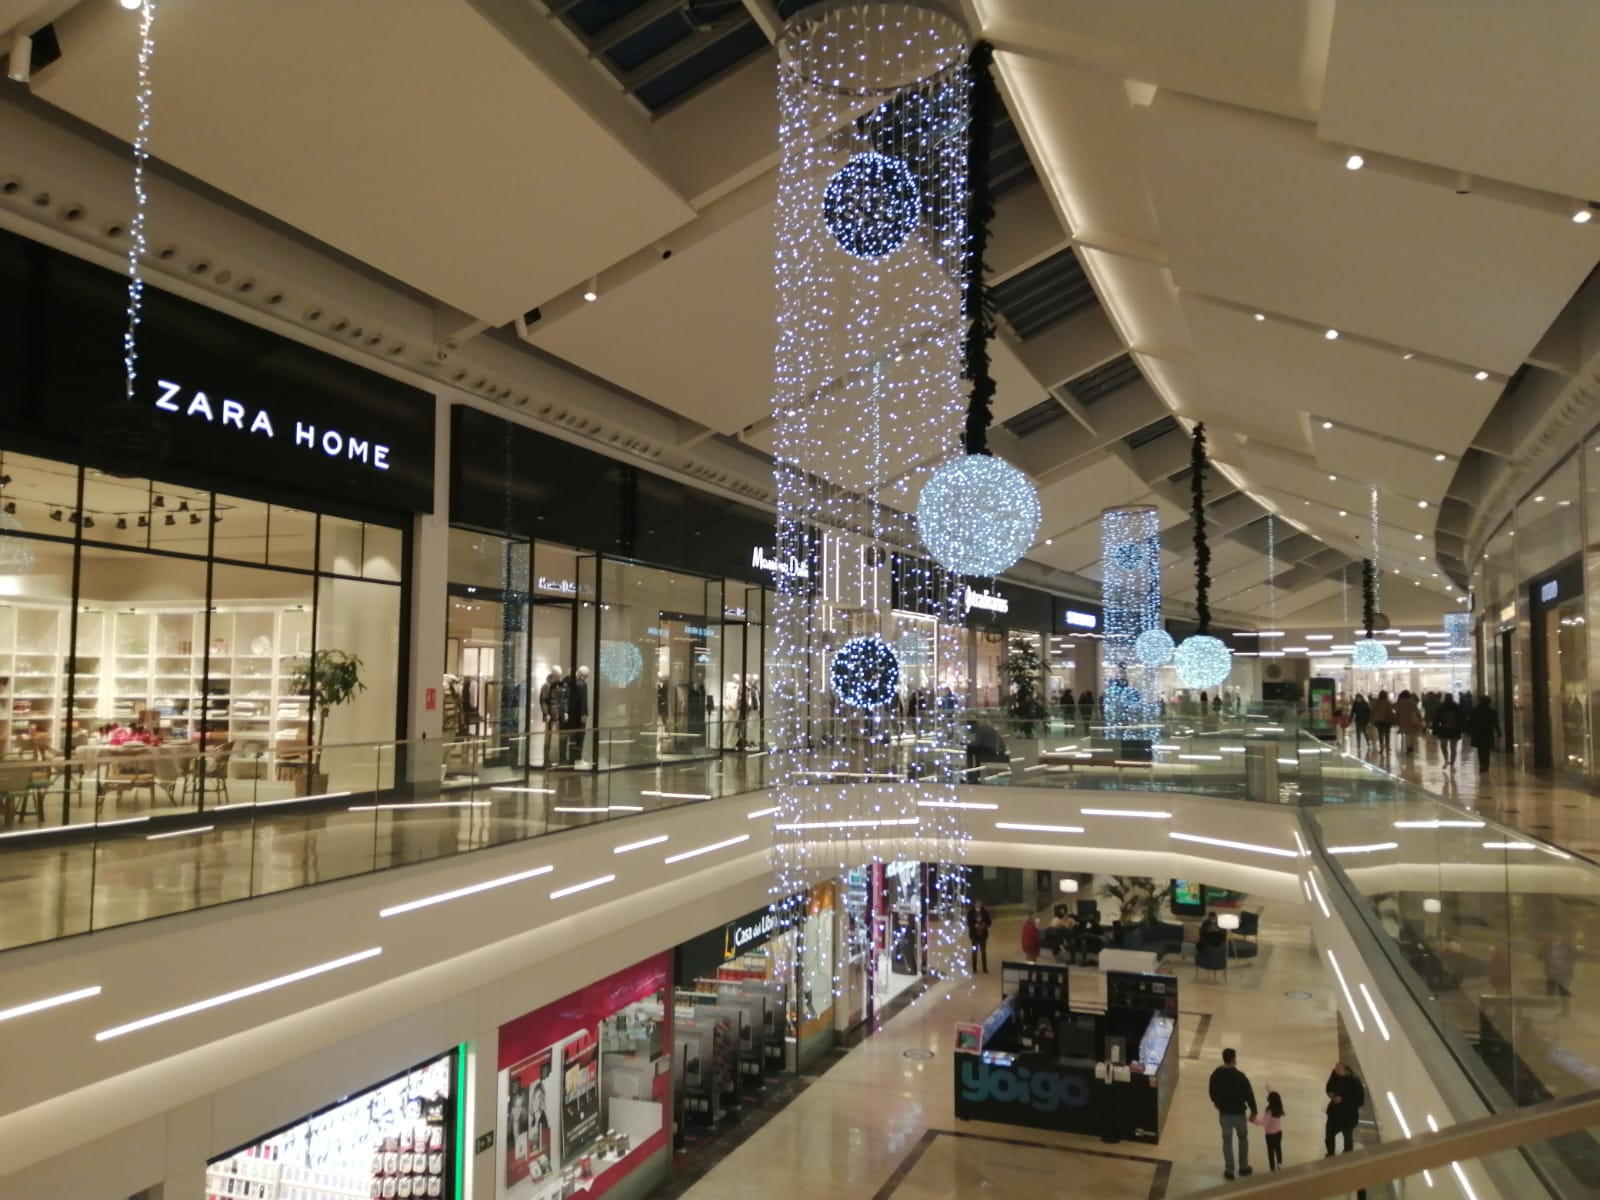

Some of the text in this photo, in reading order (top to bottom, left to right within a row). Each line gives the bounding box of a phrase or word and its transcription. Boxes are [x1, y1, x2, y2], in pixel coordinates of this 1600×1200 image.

[155, 379, 390, 470] ZARA HOME
[735, 926, 753, 947] Casa
[961, 1060, 1089, 1112] yoigo
